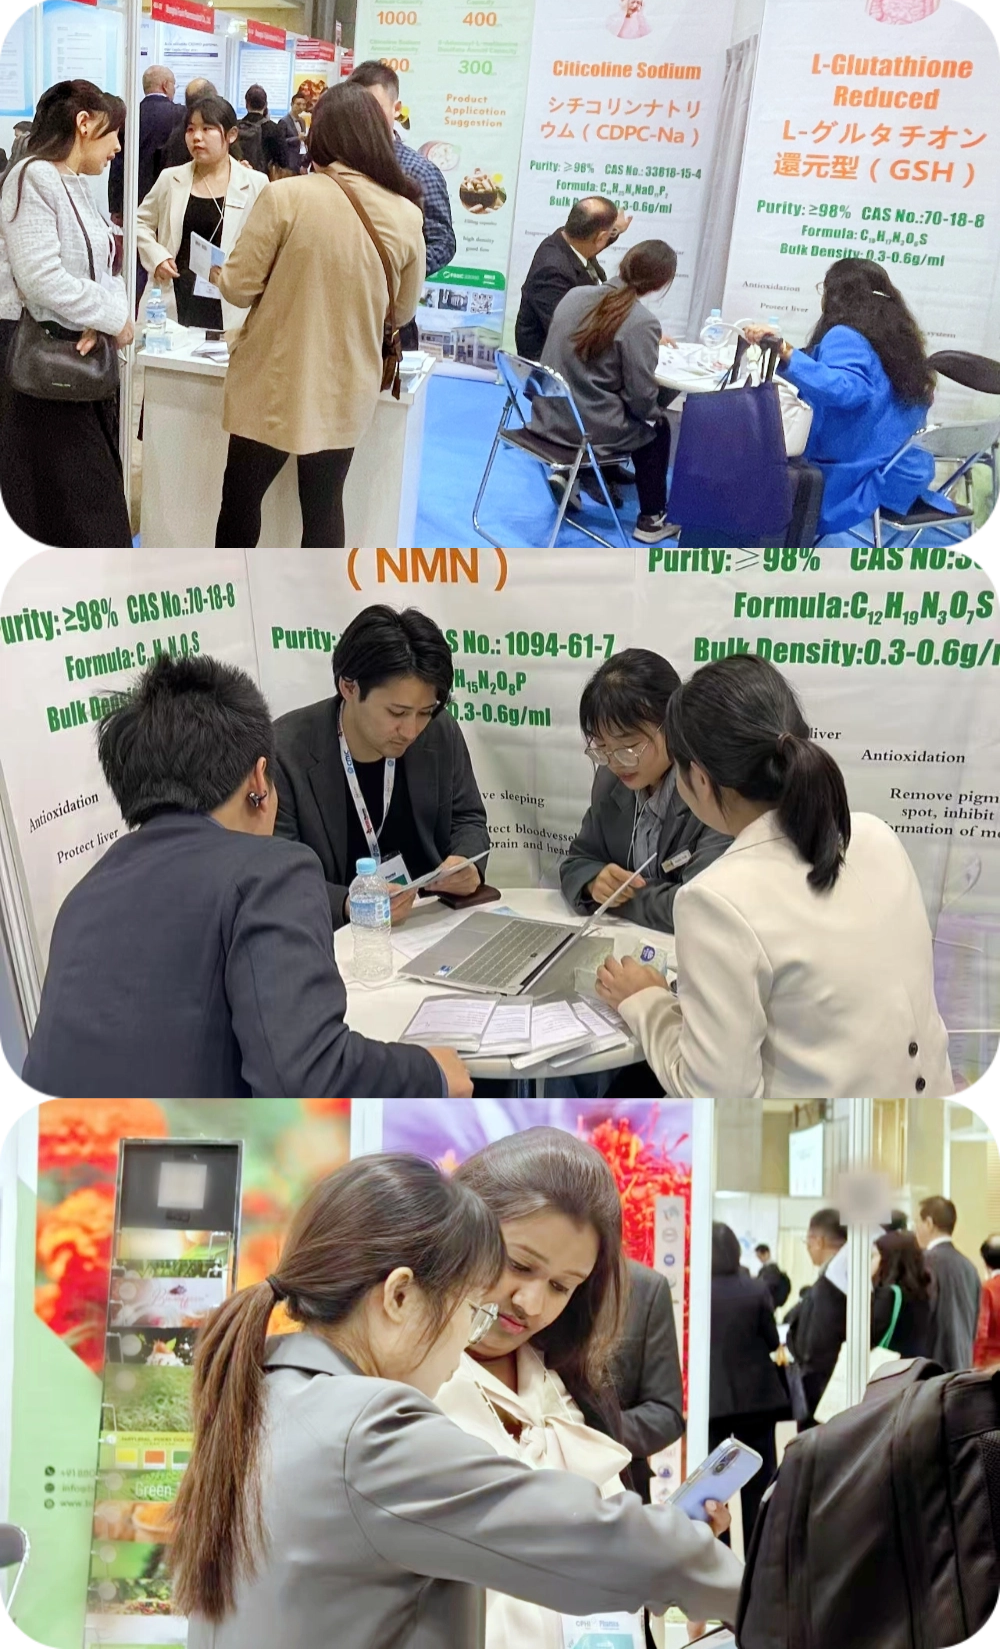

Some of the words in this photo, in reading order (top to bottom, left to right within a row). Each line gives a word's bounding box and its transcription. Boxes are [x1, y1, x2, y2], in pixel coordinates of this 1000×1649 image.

[377, 11, 417, 25] 1000
[462, 12, 498, 27] 400
[458, 60, 493, 75] 300
[552, 60, 633, 78] Citicoline
[636, 62, 702, 80] Sodium
[811, 53, 974, 79] L-Glutathione
[446, 93, 488, 103] Product
[833, 85, 941, 110] Reduced
[445, 106, 507, 116] Application
[548, 96, 701, 119] シチコリンナトリ
[444, 117, 503, 128] Suggestion
[782, 119, 988, 150] L-グルタチオン
[530, 160, 561, 174] Purity:
[605, 164, 624, 176] CAS
[556, 179, 598, 193] Formula:
[549, 196, 571, 207] Bulk
[756, 199, 805, 217] Purity:
[861, 206, 892, 222] CAS
[801, 225, 858, 240] Formula:
[780, 243, 808, 256] Bulk
[811, 244, 864, 259] Density:
[742, 280, 800, 292] Antioxidation
[760, 302, 788, 312] Protect
[649, 548, 732, 574] Purity:
[850, 548, 905, 571] CAS
[127, 591, 160, 624] CAS
[271, 626, 336, 652] Purity:
[463, 630, 501, 655] No.:
[505, 631, 615, 659] 1094-61-7
[694, 637, 750, 662] Bulk
[65, 646, 136, 682] Formula:
[46, 700, 89, 733] Bulk
[809, 727, 842, 740] liver
[861, 749, 966, 763] Antioxidation
[500, 790, 545, 808] sleeping
[890, 787, 953, 801] Remove
[28, 793, 100, 834] Antioxidation
[901, 807, 938, 819] spot,
[944, 806, 995, 820] inhibit
[960, 825, 979, 837] of
[56, 838, 95, 865] Protect
[97, 828, 119, 846] liver
[523, 840, 543, 851] and
[135, 1481, 172, 1498] Green
